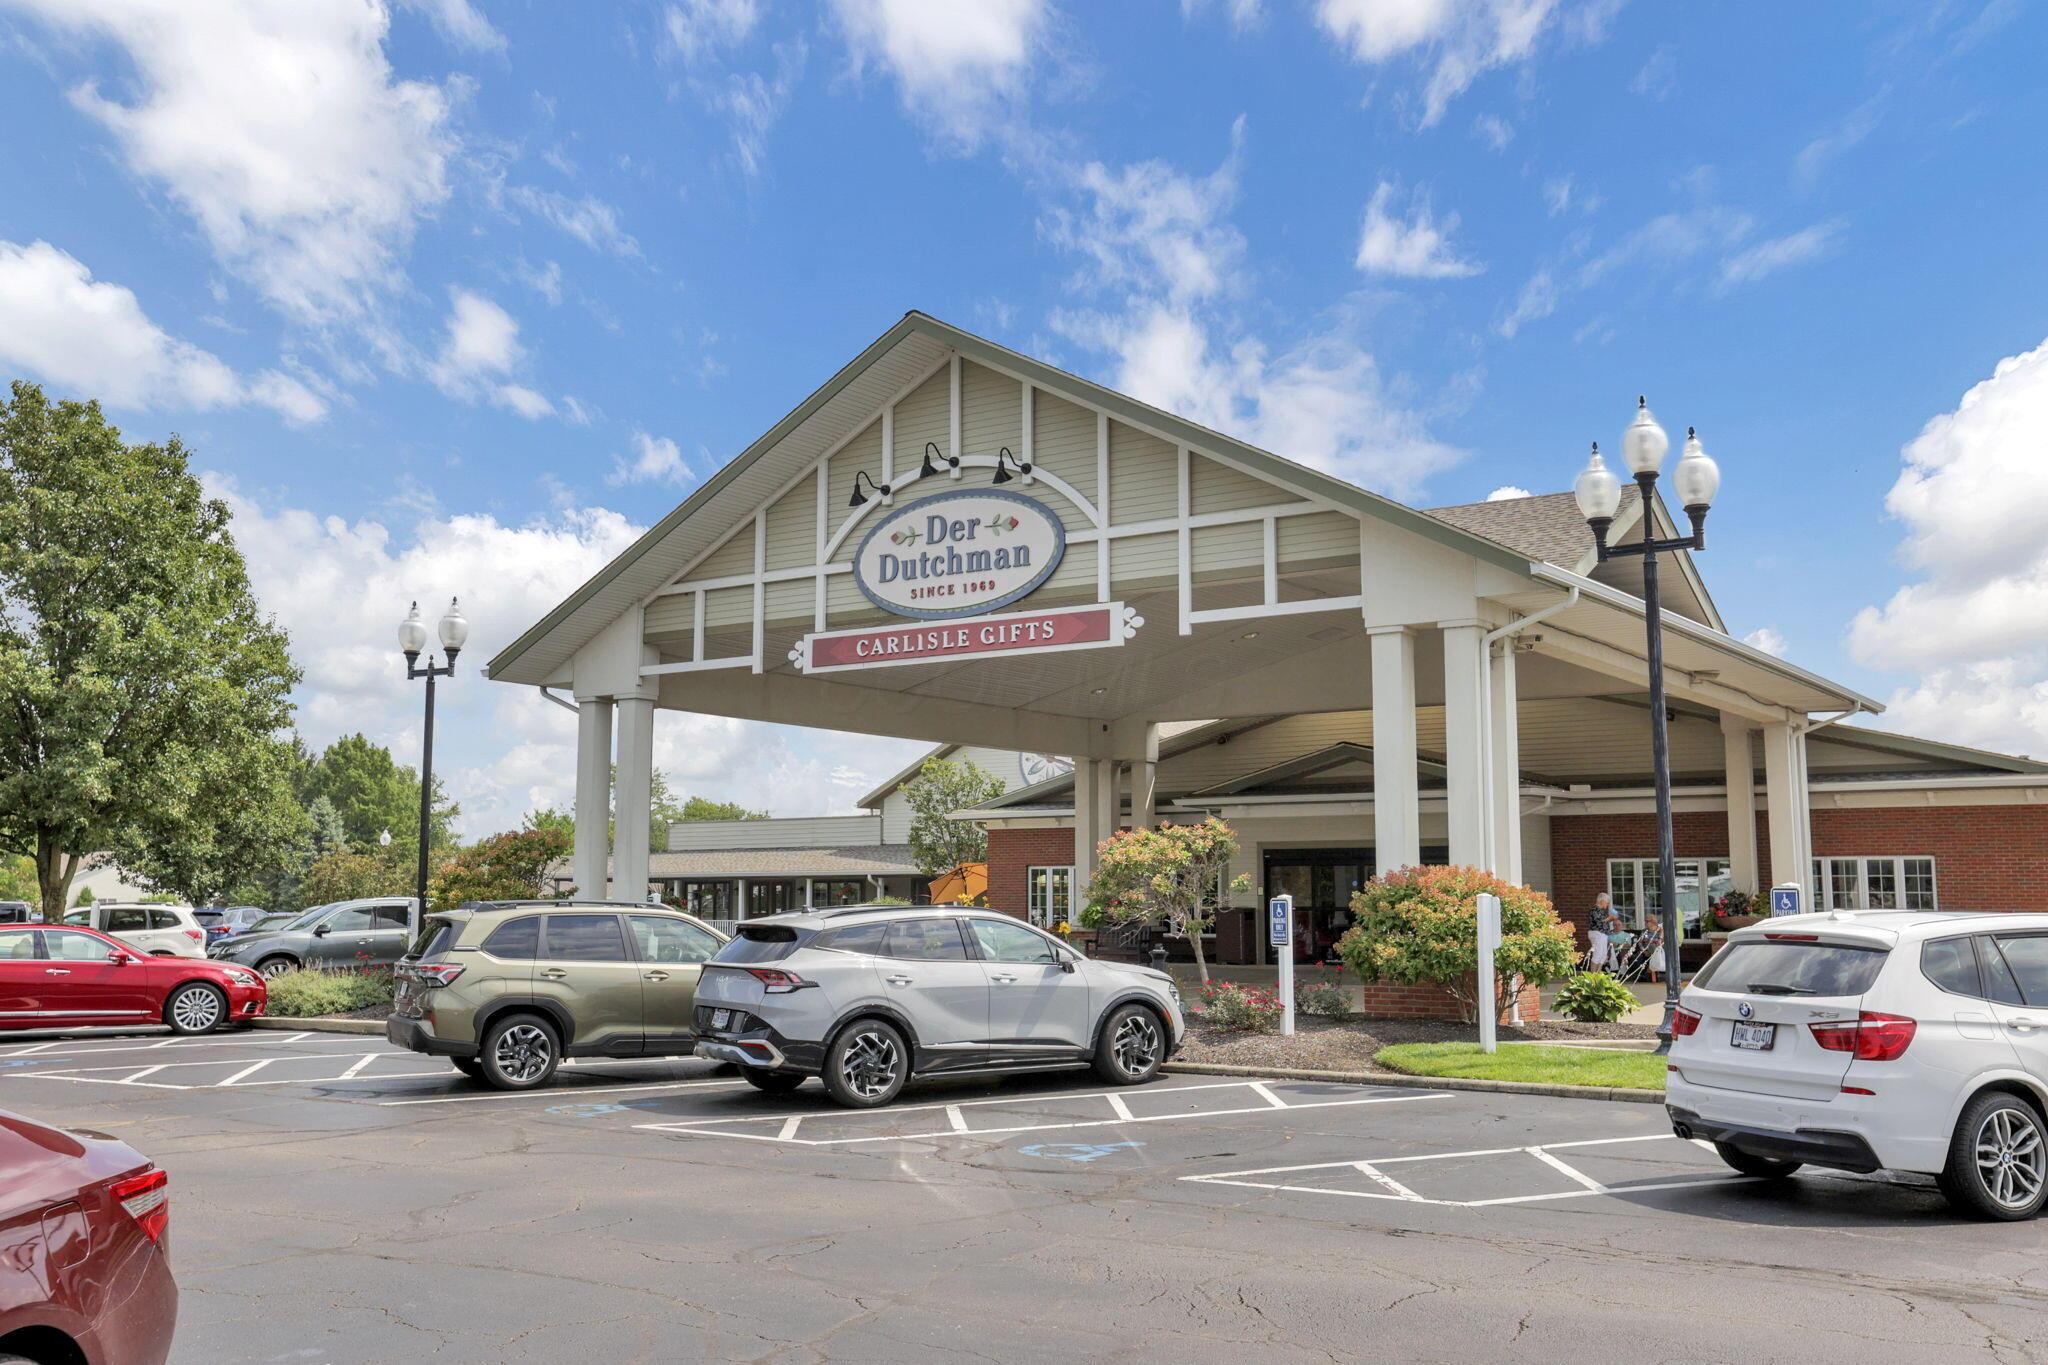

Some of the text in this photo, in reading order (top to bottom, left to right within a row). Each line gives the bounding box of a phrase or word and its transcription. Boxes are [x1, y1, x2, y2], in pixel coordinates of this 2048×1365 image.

[926, 514, 981, 545] Der
[879, 544, 1031, 583] Dutchman
[910, 579, 996, 599] SINCE 1969
[856, 620, 1055, 657] CARLISLE GIFTS
